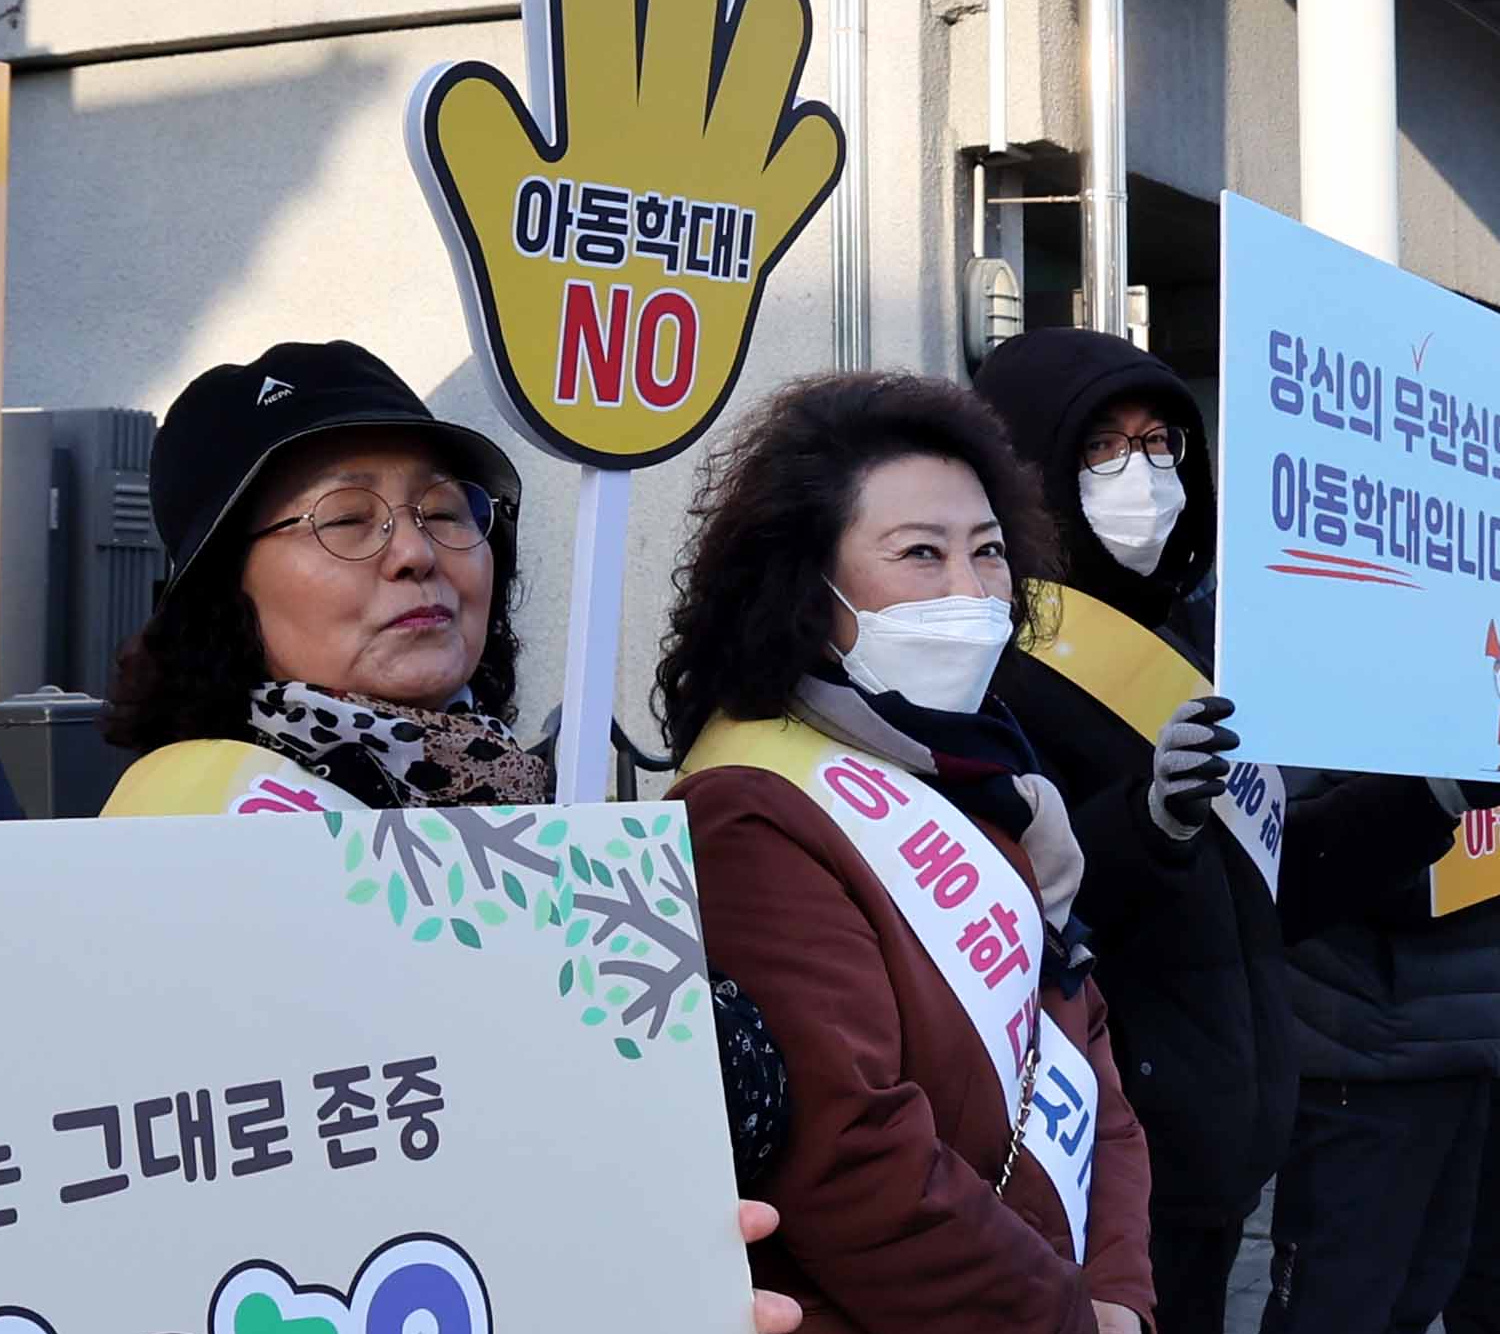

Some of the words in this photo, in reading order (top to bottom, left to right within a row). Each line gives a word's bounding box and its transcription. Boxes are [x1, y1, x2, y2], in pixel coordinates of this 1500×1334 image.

[514, 178, 754, 280] 아동학대!
[264, 387, 293, 406] NEPA
[557, 281, 698, 409] NO
[1269, 329, 1382, 442] 당신의
[52, 1079, 292, 1204] 그대로
[312, 1055, 444, 1170] 존중
